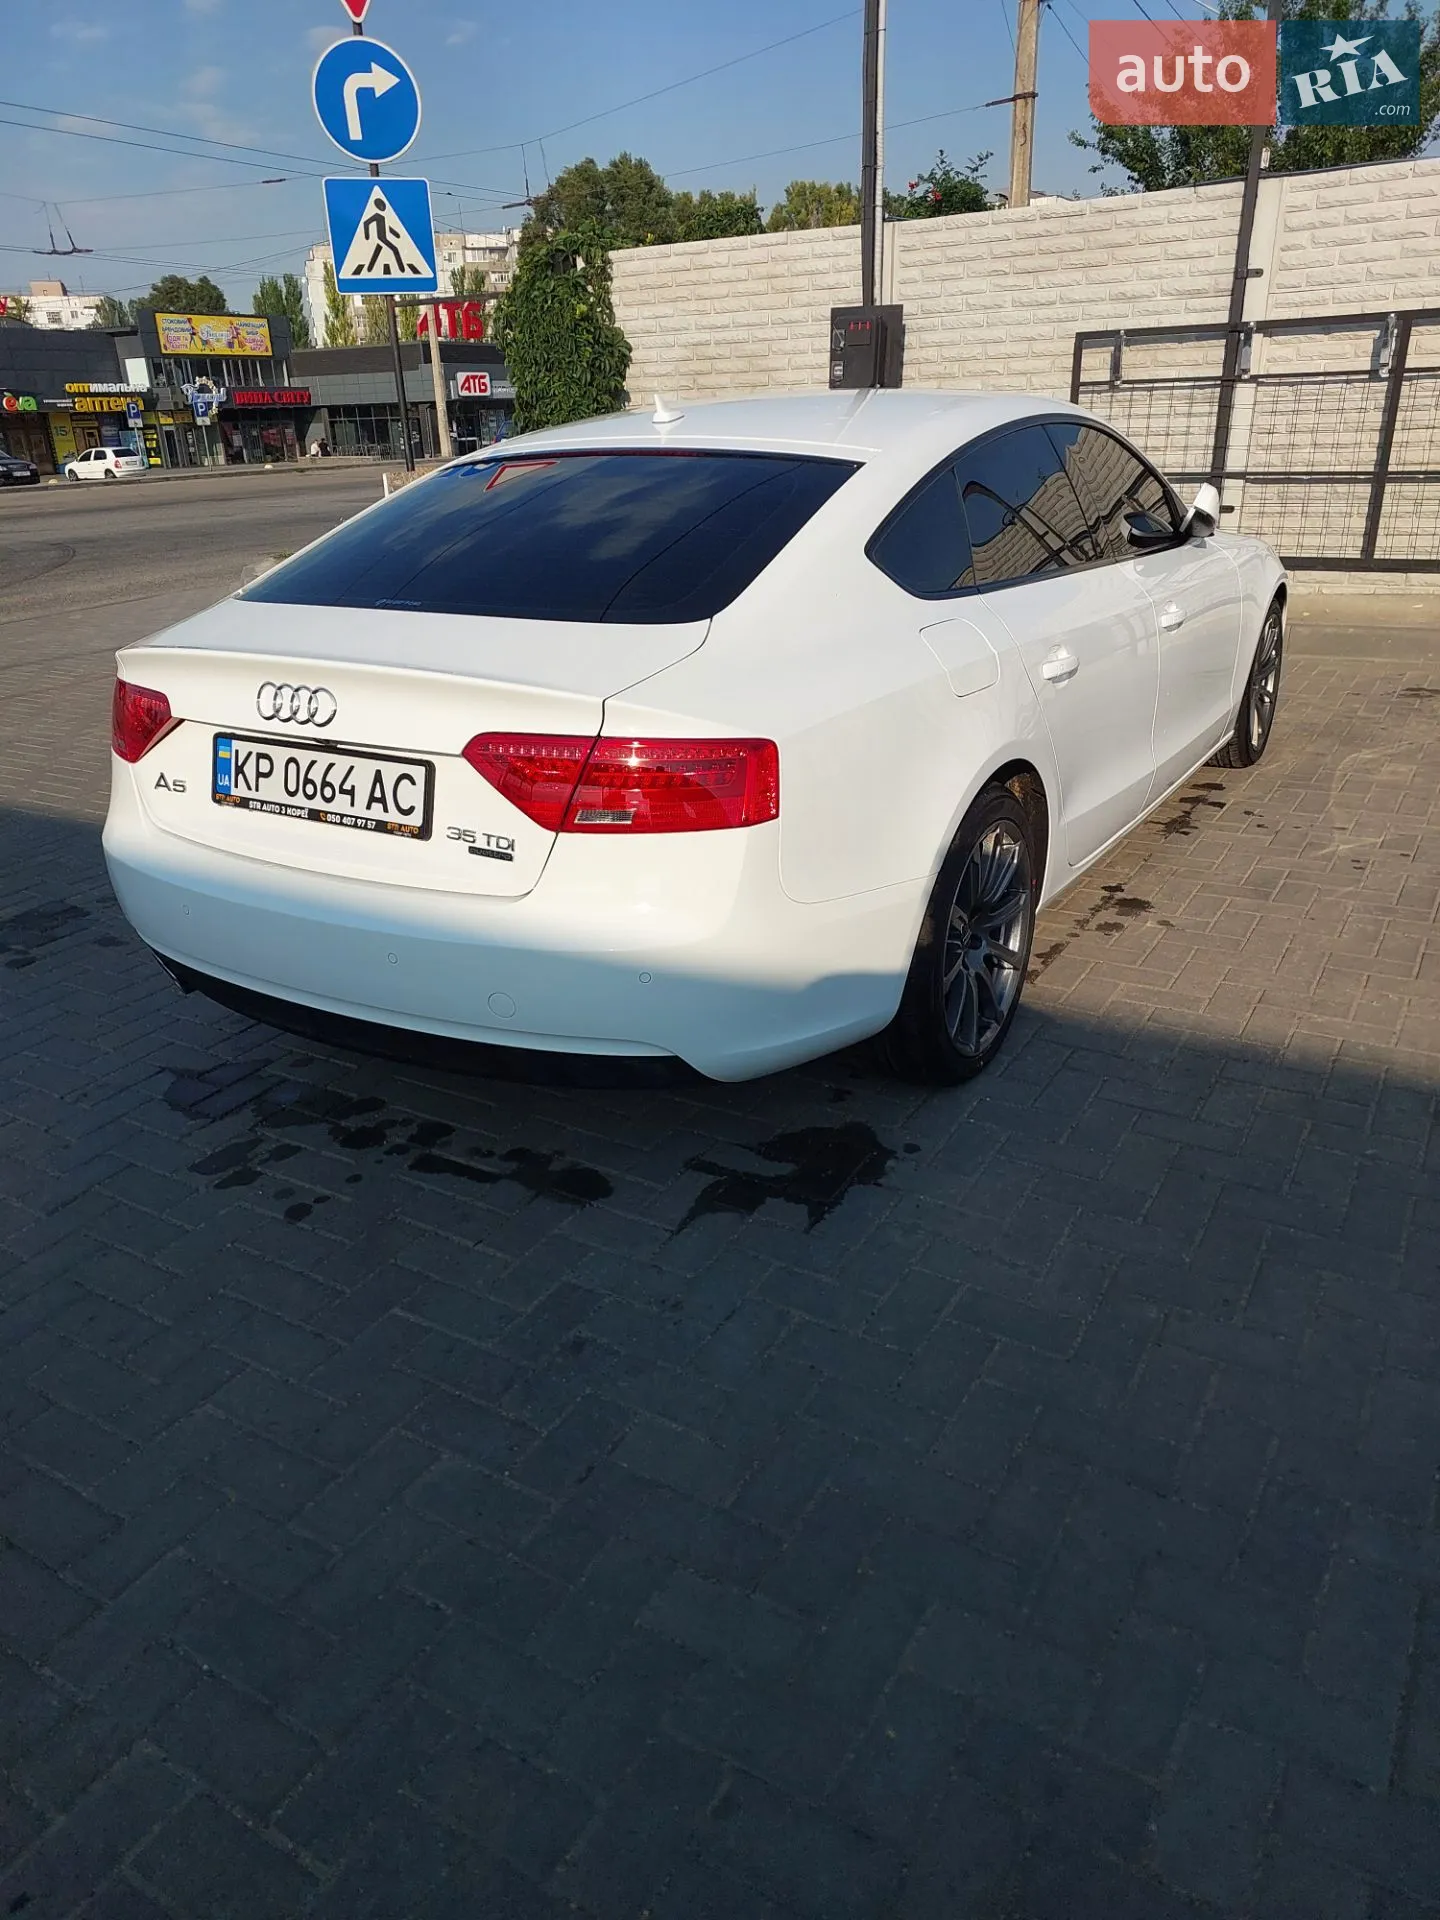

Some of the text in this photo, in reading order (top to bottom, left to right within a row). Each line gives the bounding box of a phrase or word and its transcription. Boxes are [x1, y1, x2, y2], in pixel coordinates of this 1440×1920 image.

[65, 383, 148, 393] оптимальна
[460, 375, 488, 393] АТБ
[154, 772, 187, 793] A5
[217, 774, 230, 786] UA
[234, 749, 417, 817] KP 0664 AC
[248, 801, 262, 809] STR
[262, 803, 280, 813] AUTO
[326, 813, 376, 829] 050 407 97 57
[400, 824, 419, 834] AUTO
[446, 826, 516, 852] 35 TDI
